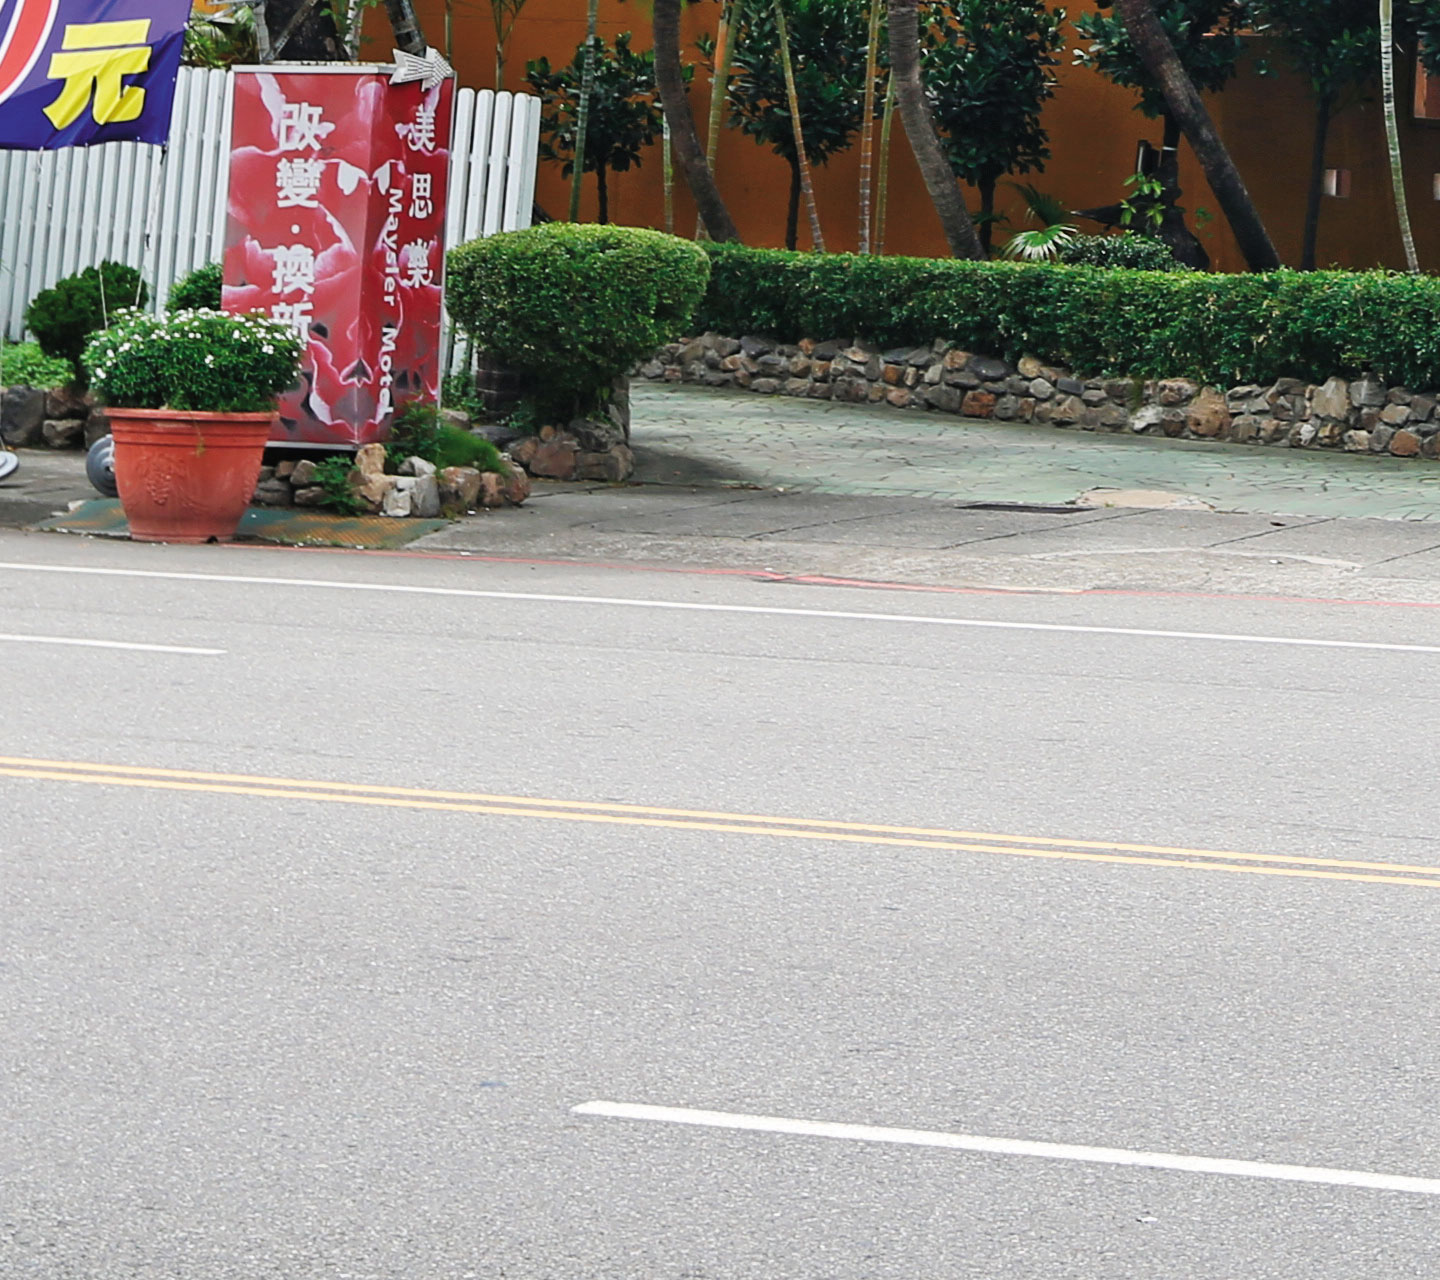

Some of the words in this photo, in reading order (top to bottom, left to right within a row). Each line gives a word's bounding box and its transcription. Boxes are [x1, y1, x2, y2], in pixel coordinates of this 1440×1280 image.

[381, 188, 404, 307] Maysler
[402, 103, 437, 289] 美思樂
